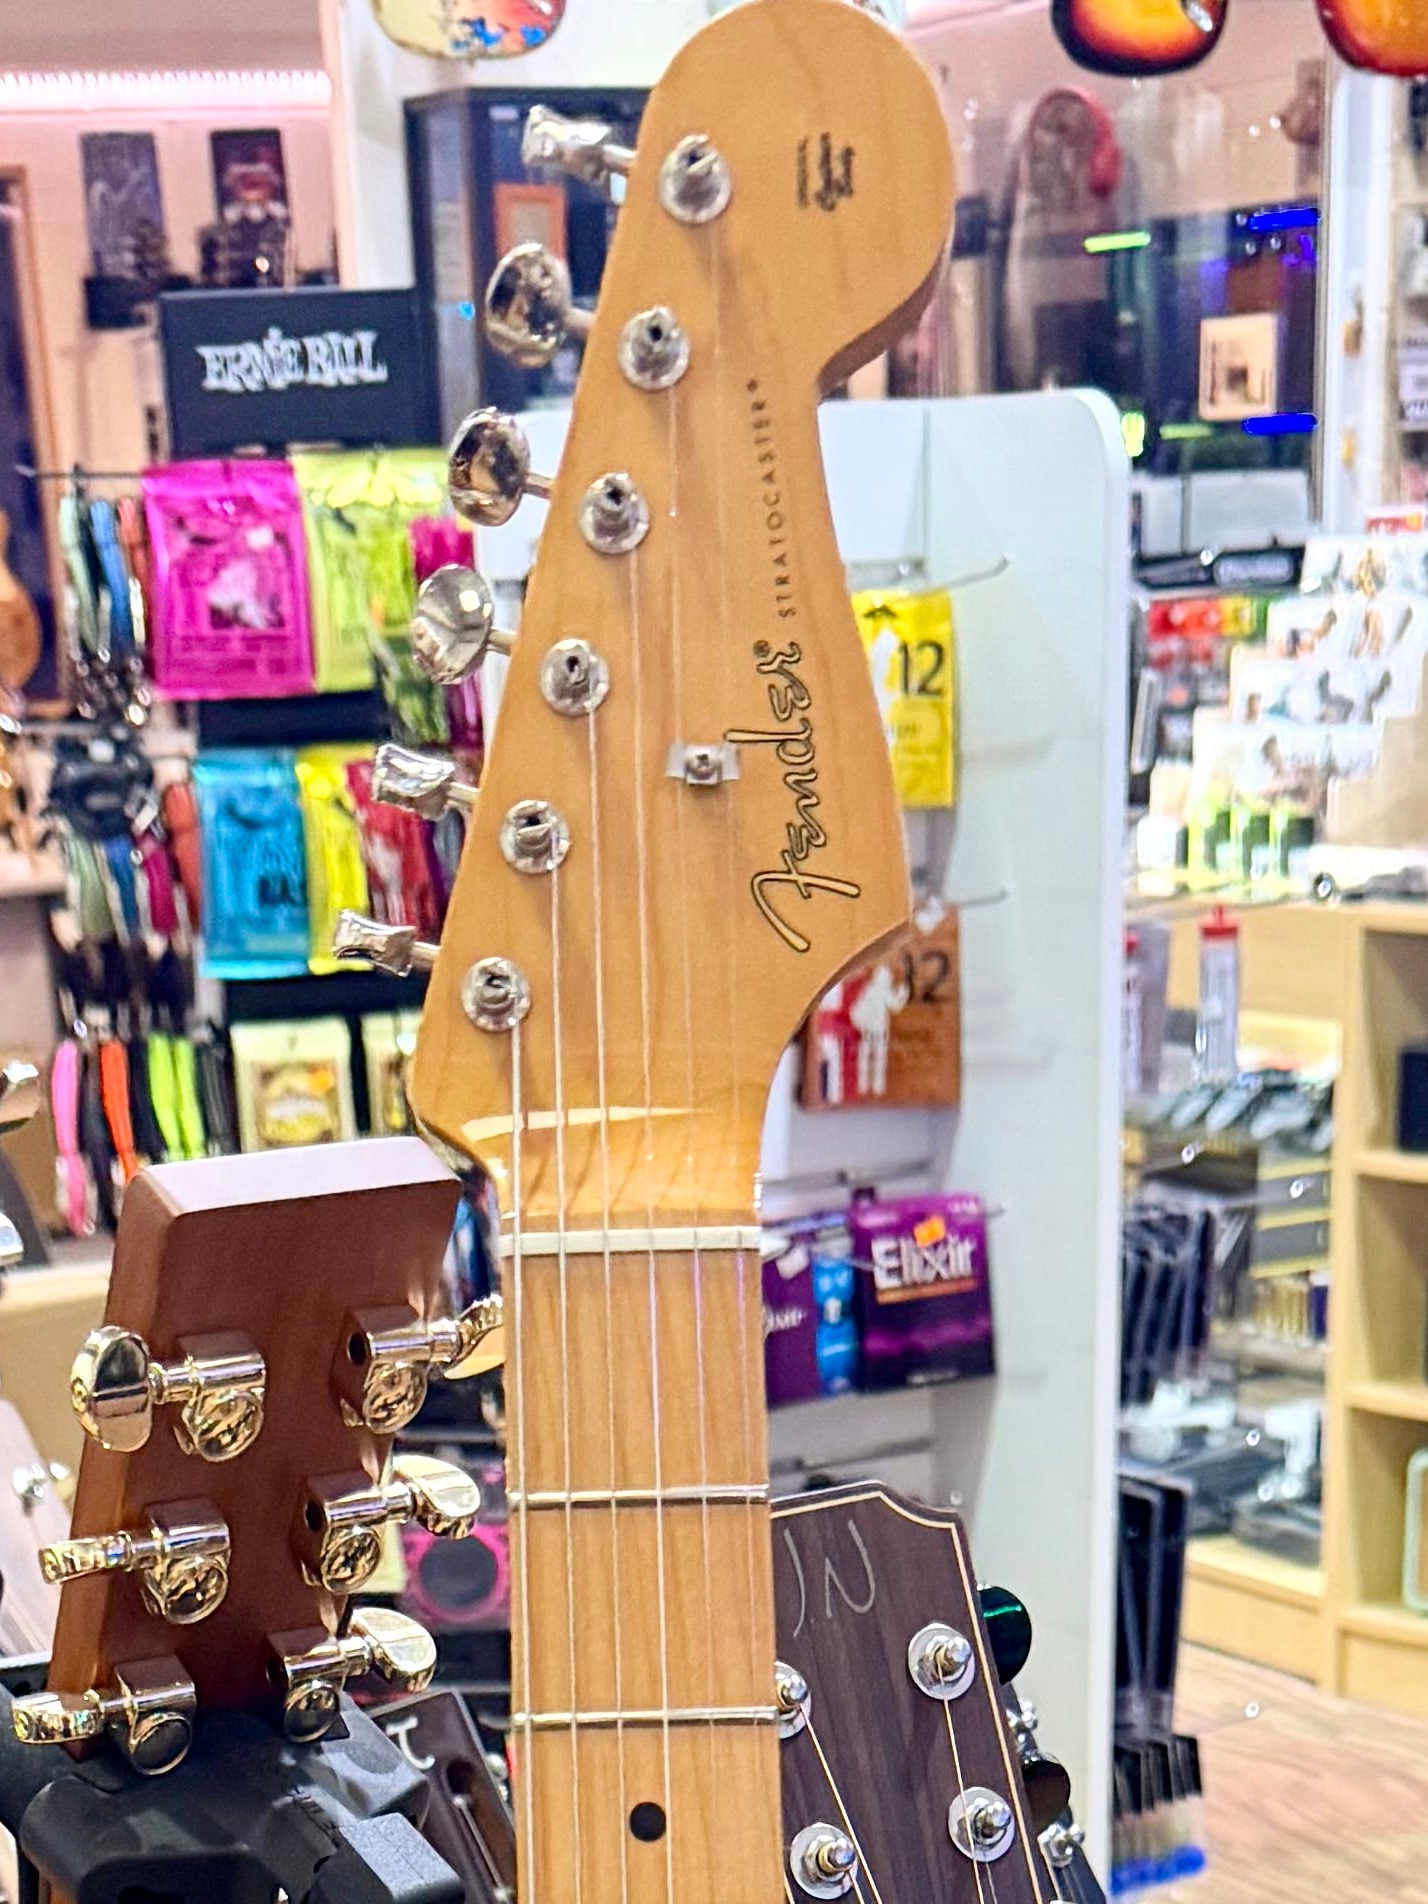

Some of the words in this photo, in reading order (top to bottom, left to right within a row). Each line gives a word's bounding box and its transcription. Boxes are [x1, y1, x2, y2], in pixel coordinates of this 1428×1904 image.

[195, 326, 304, 394] ERNIE
[305, 329, 389, 387] BALL
[750, 400, 797, 619] STRATOCASTER
[897, 639, 947, 697] 12
[723, 640, 861, 953] Fender
[903, 948, 955, 1004] 12
[870, 1234, 977, 1290] Elixir
